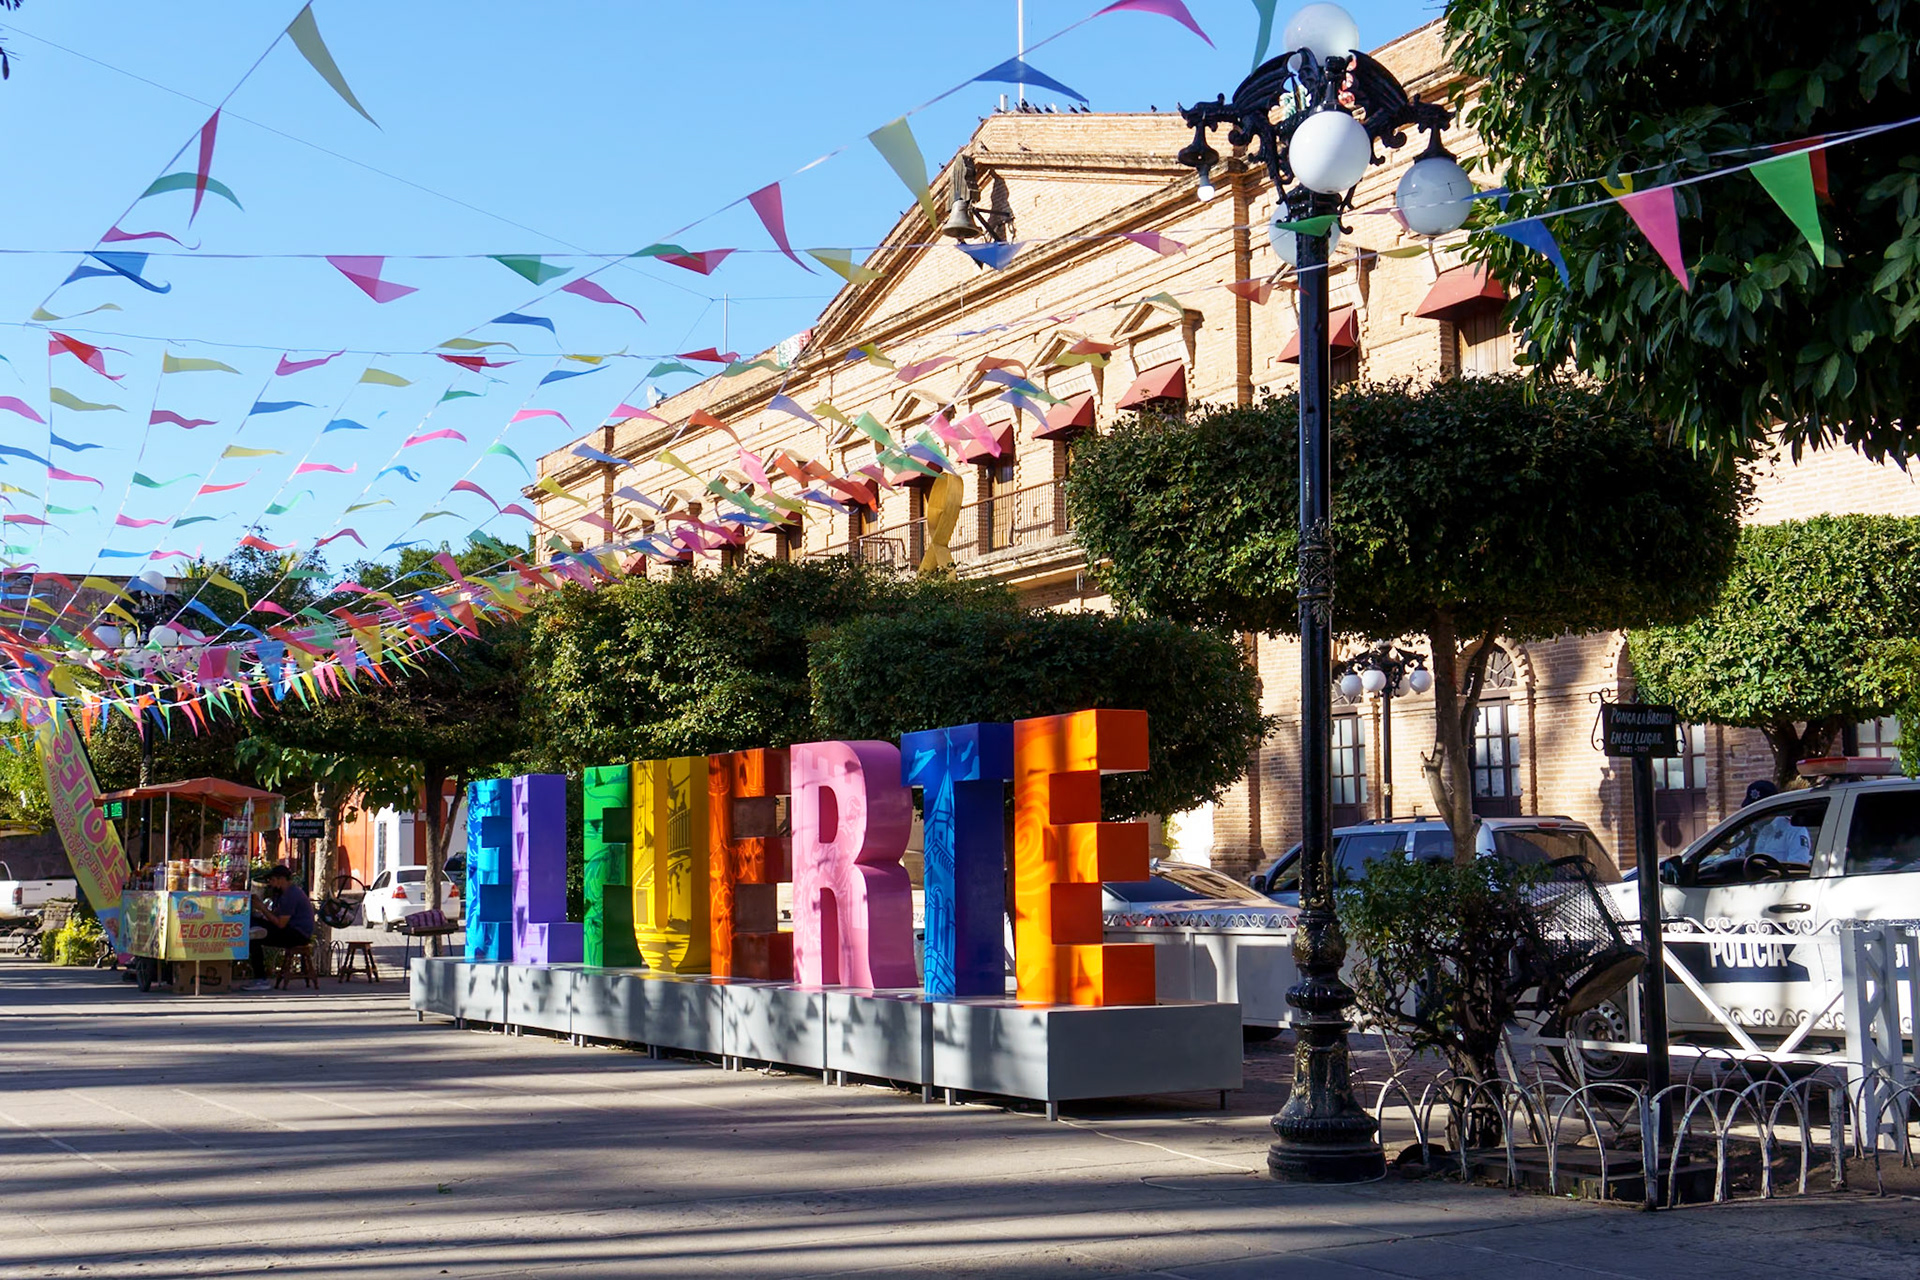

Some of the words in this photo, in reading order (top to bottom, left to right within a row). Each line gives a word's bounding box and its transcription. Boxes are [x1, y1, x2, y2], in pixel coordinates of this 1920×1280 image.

[1610, 731, 1621, 744] EN
[464, 774, 583, 965] EL
[583, 708, 1156, 1008] FUERTE
[178, 922, 245, 939] ELOTES
[1709, 942, 1788, 968] POLICIA
